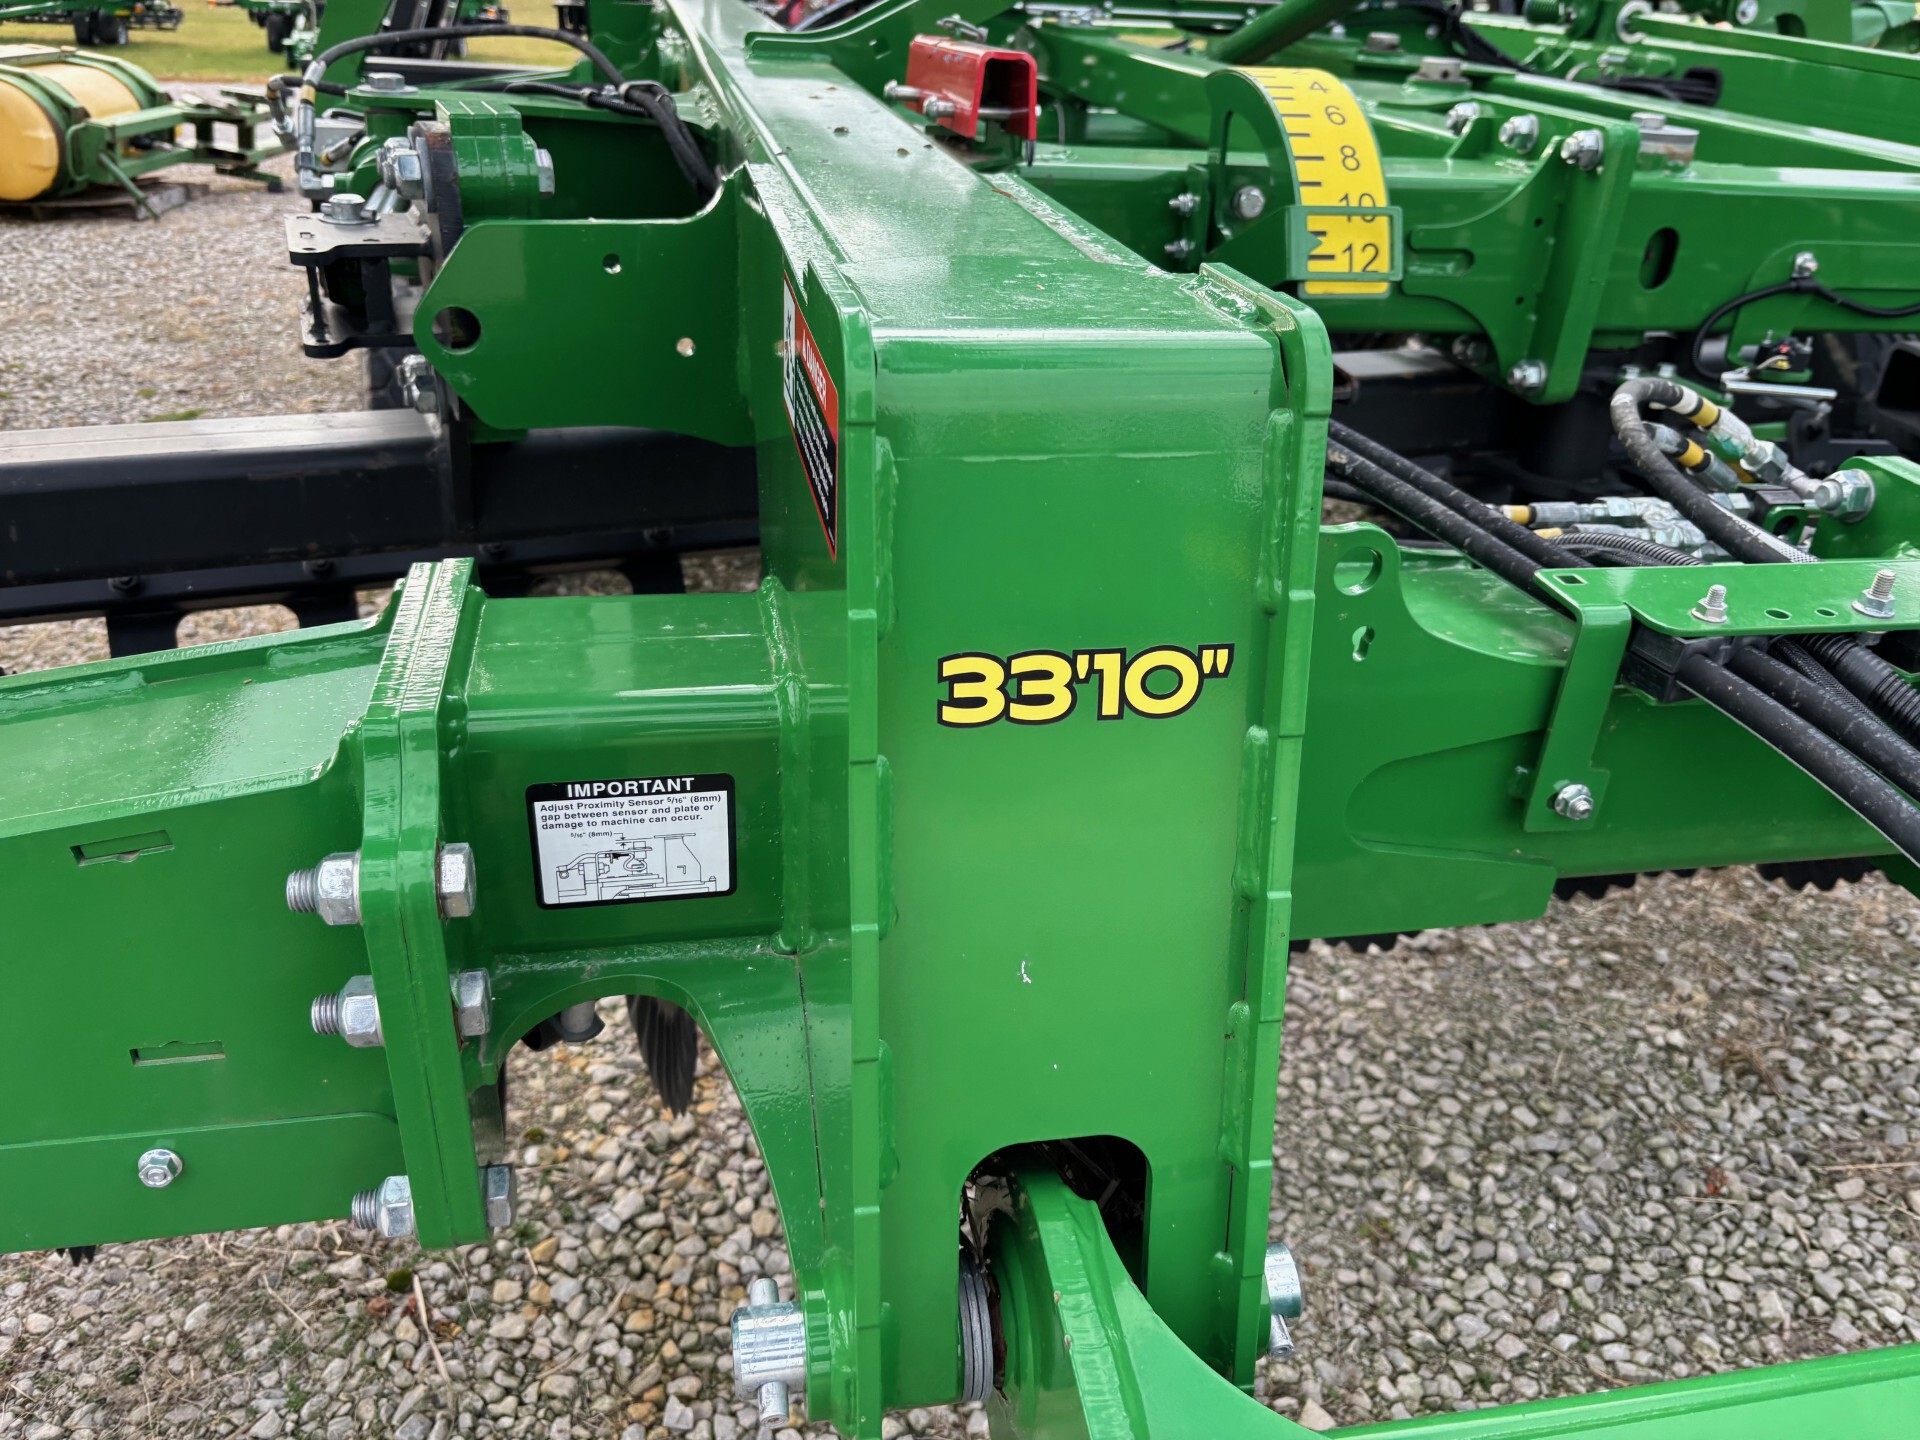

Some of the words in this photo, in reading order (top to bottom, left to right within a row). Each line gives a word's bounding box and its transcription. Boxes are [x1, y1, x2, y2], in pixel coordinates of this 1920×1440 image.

[1309, 81, 1329, 94] 4
[1325, 105, 1346, 126] 6
[1340, 145, 1360, 171] 8
[1338, 193, 1376, 223] 10
[1342, 243, 1379, 273] 12
[805, 337, 827, 411] DANGER
[938, 644, 1235, 728] 33'10"
[566, 777, 695, 798] IMPORTANT
[540, 803, 573, 813] Adjust
[577, 800, 625, 810] Proximity
[628, 799, 665, 807] Sensor
[690, 794, 721, 804] (8mm)
[540, 813, 561, 823] gap
[564, 810, 609, 820] between
[612, 809, 648, 817] sensor
[651, 806, 671, 814] and
[674, 804, 700, 814] plate
[541, 821, 583, 830] damage
[601, 817, 645, 826] machine
[671, 814, 703, 822] occur.
[588, 830, 613, 839] (8mm)
